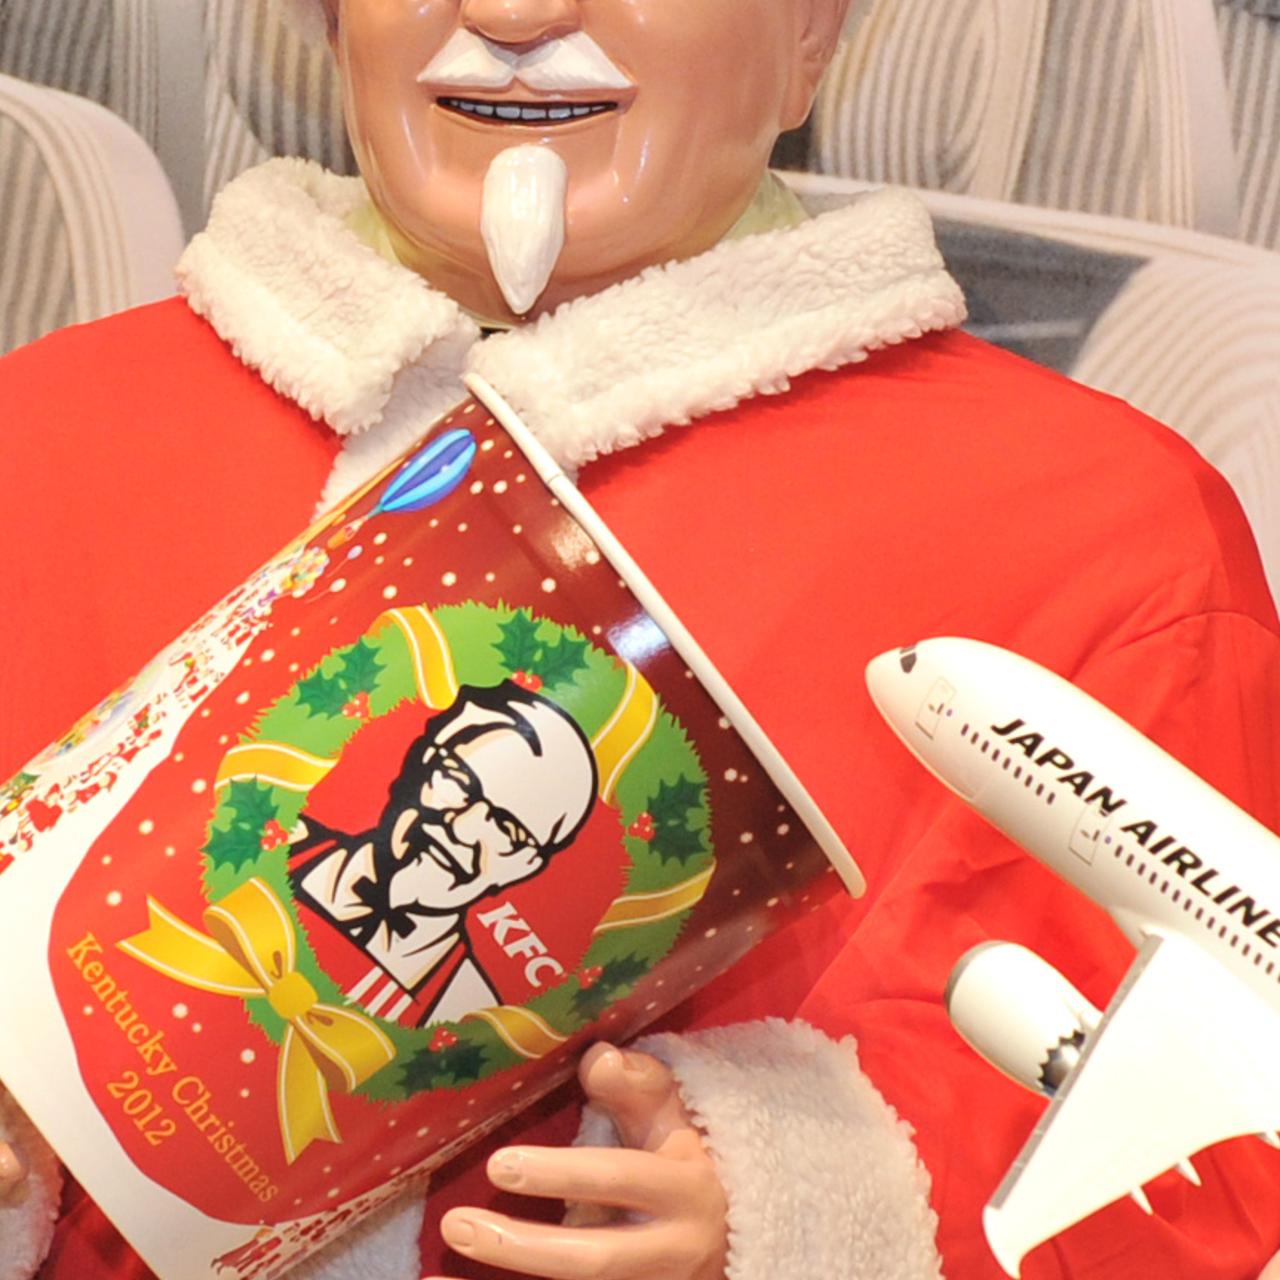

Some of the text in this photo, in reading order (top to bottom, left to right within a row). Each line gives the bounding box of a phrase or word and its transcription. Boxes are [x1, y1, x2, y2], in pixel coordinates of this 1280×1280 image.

[990, 718, 1127, 814] JAPAN
[476, 901, 564, 988] KFC
[66, 931, 280, 1203] Kentucky Christmas
[106, 1070, 176, 1147] 2012
